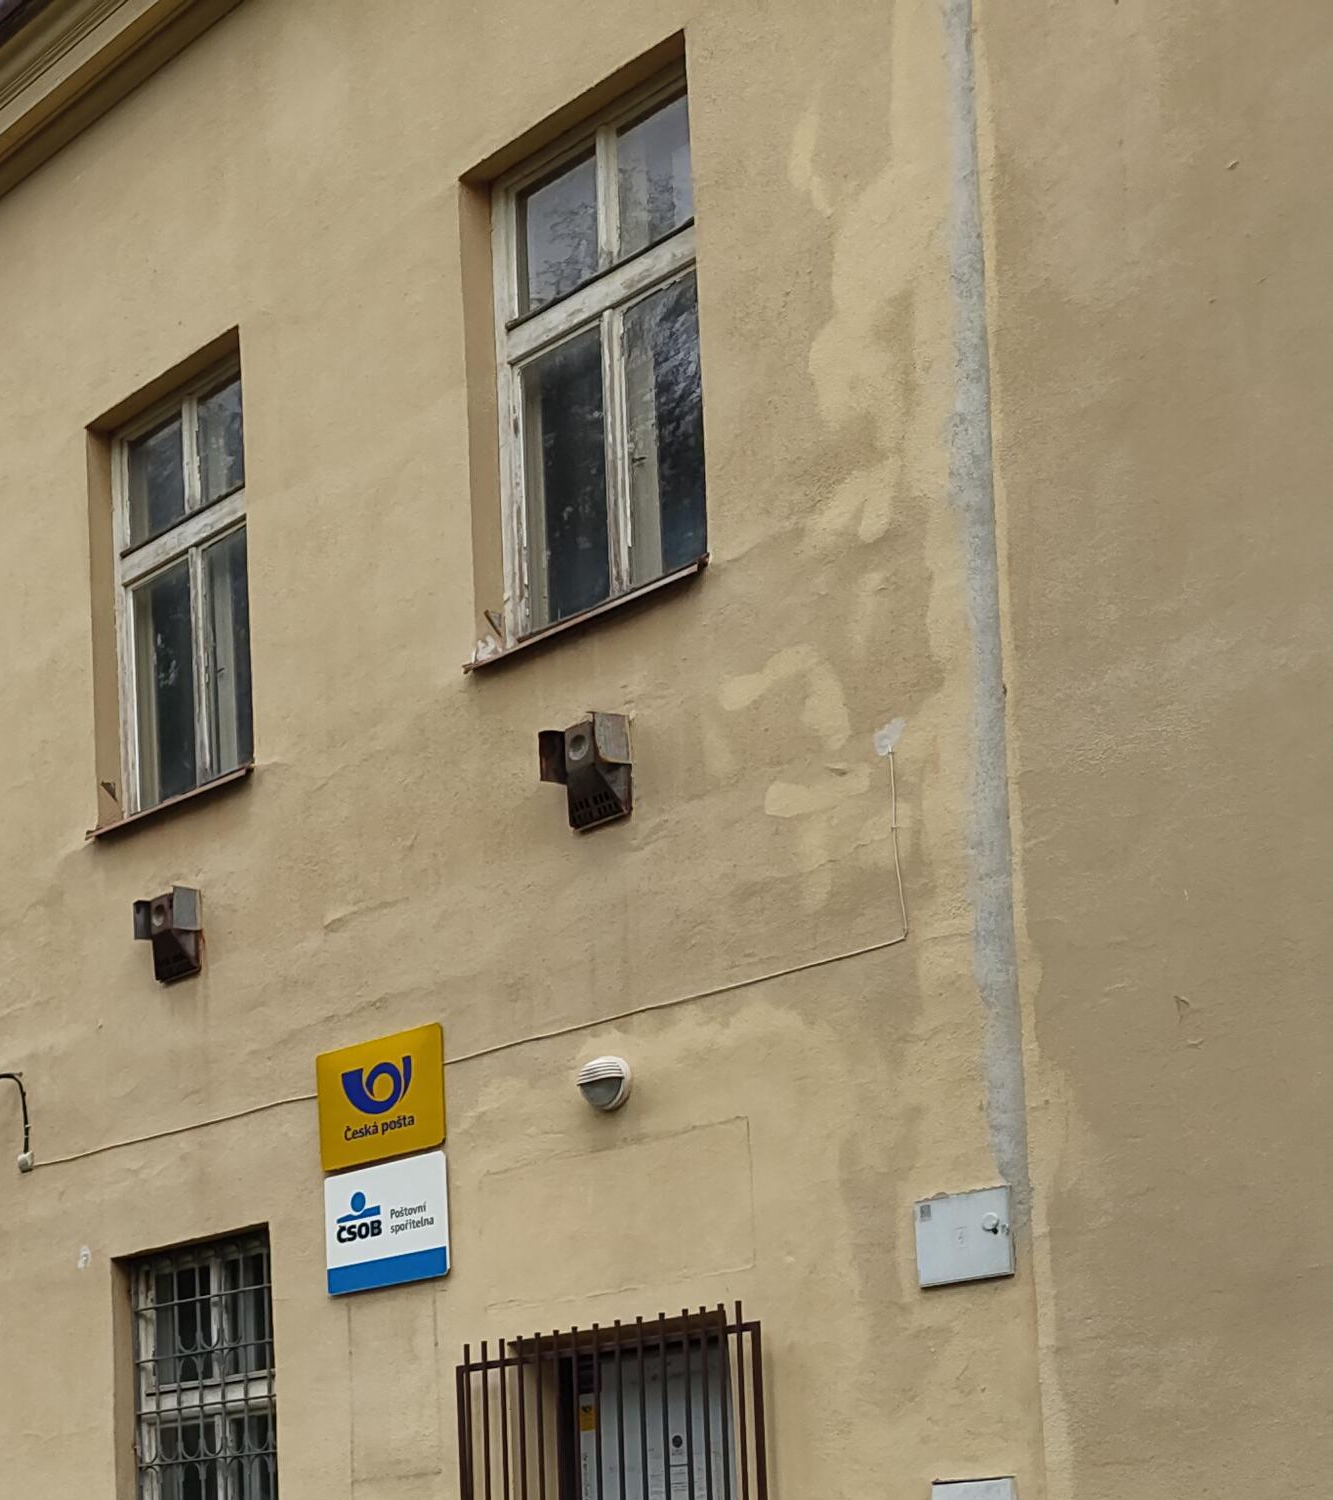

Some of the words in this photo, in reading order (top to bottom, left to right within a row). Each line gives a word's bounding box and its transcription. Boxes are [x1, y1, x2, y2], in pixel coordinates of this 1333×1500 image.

[344, 1121, 379, 1142] Česká
[381, 1114, 415, 1135] pošta
[390, 1201, 427, 1219] Poštovní
[336, 1219, 383, 1244] ČSOB
[390, 1216, 435, 1235] spořitelna
